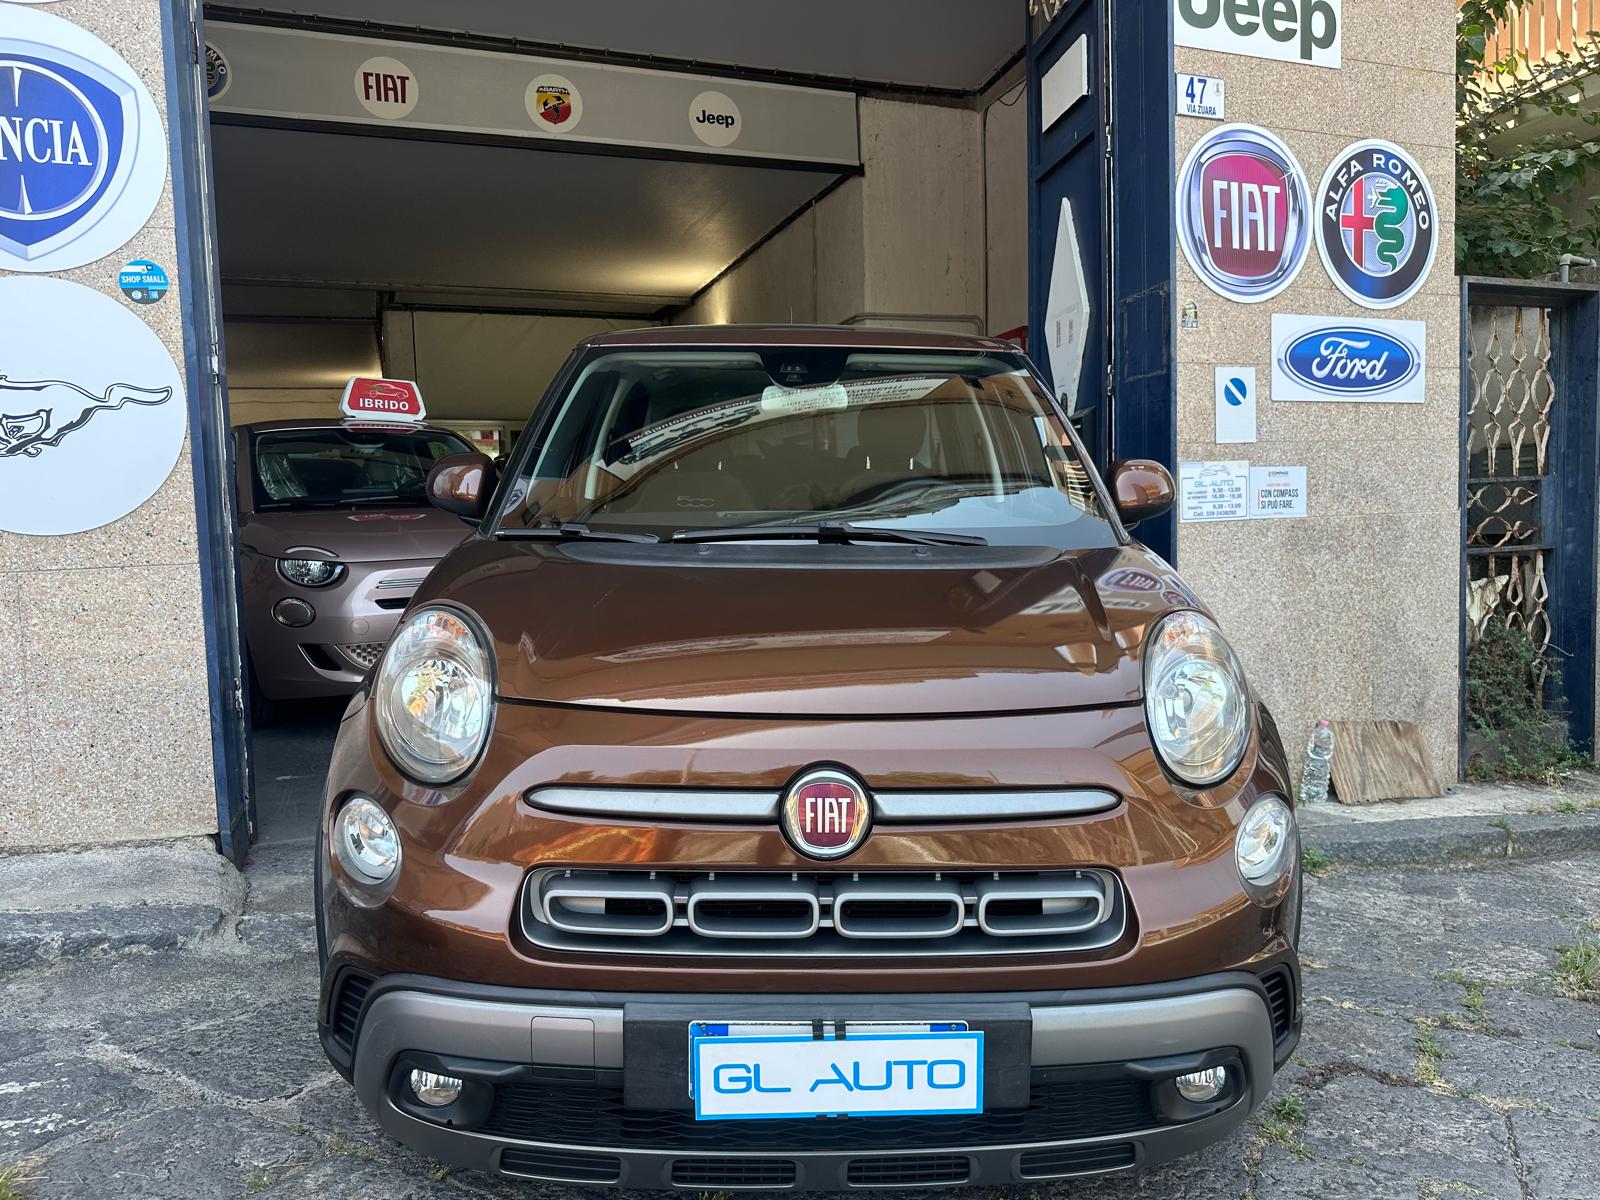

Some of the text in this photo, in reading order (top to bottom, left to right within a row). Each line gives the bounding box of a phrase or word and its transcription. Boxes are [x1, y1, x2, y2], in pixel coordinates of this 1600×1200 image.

[207, 50, 226, 74] MEO
[363, 72, 409, 104] FIAT
[1186, 77, 1207, 104] 47
[696, 110, 735, 128] Jeep
[1187, 104, 1216, 115] VIA ZUARA
[0, 115, 92, 166] NCIA
[1326, 153, 1429, 230] ALFA ROMEO
[1212, 179, 1281, 252] FIAT
[121, 275, 166, 283] SHOP SMALL
[1311, 336, 1389, 381] Ford
[360, 398, 409, 410] IBRIDO
[1261, 489, 1298, 498] CON COMPASS
[1261, 500, 1266, 509] SI
[805, 797, 850, 833] FIAT
[713, 1059, 966, 1094] GL AUTO
